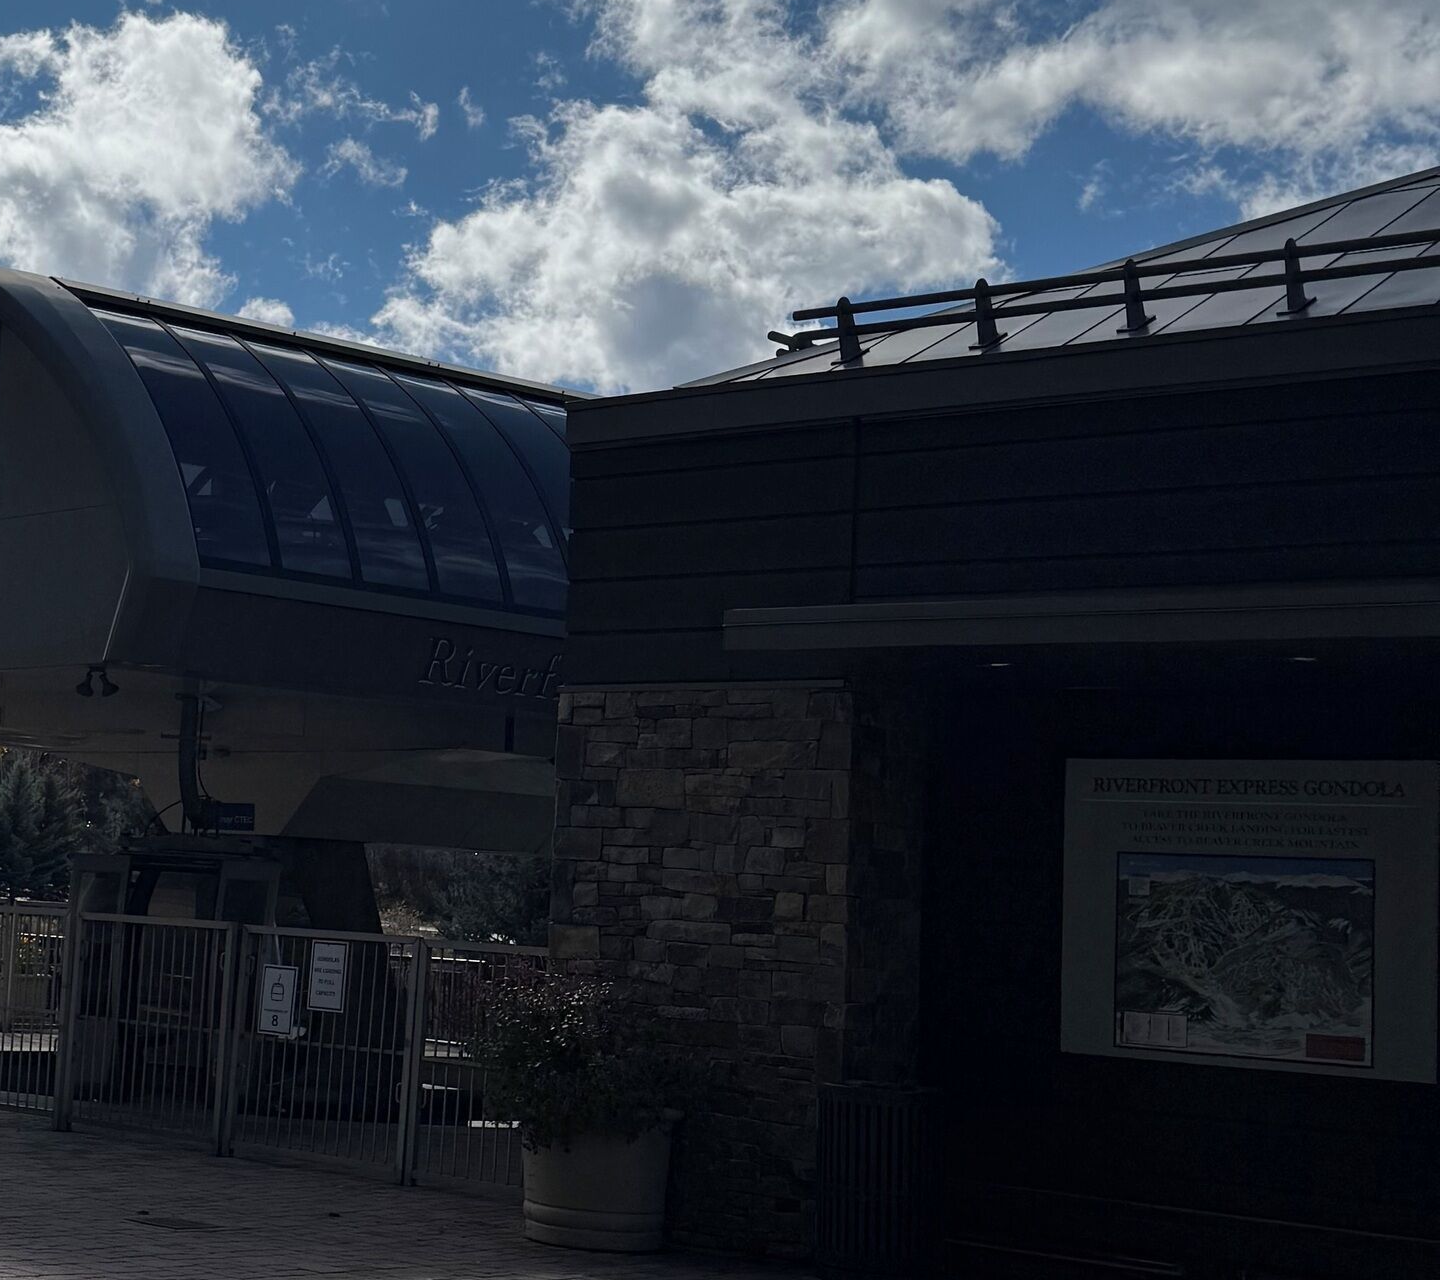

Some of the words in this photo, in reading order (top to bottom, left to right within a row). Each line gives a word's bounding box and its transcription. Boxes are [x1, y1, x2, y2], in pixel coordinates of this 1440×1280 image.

[1092, 777, 1211, 795] RIVERFRONT
[1216, 779, 1298, 796] EXPRESS
[1303, 780, 1406, 798] GONDOLA
[1176, 810, 1199, 820] THE
[1202, 810, 1280, 821] RIVERFRONT
[1284, 812, 1348, 823] GONDOLA
[1141, 822, 1186, 832] BEAVER
[1188, 823, 1228, 833] CREEK
[1195, 836, 1241, 846] BEAVER
[1243, 837, 1284, 848] CREEK
[1287, 839, 1361, 849] MOUNTAIN
[271, 1014, 279, 1027] 8
